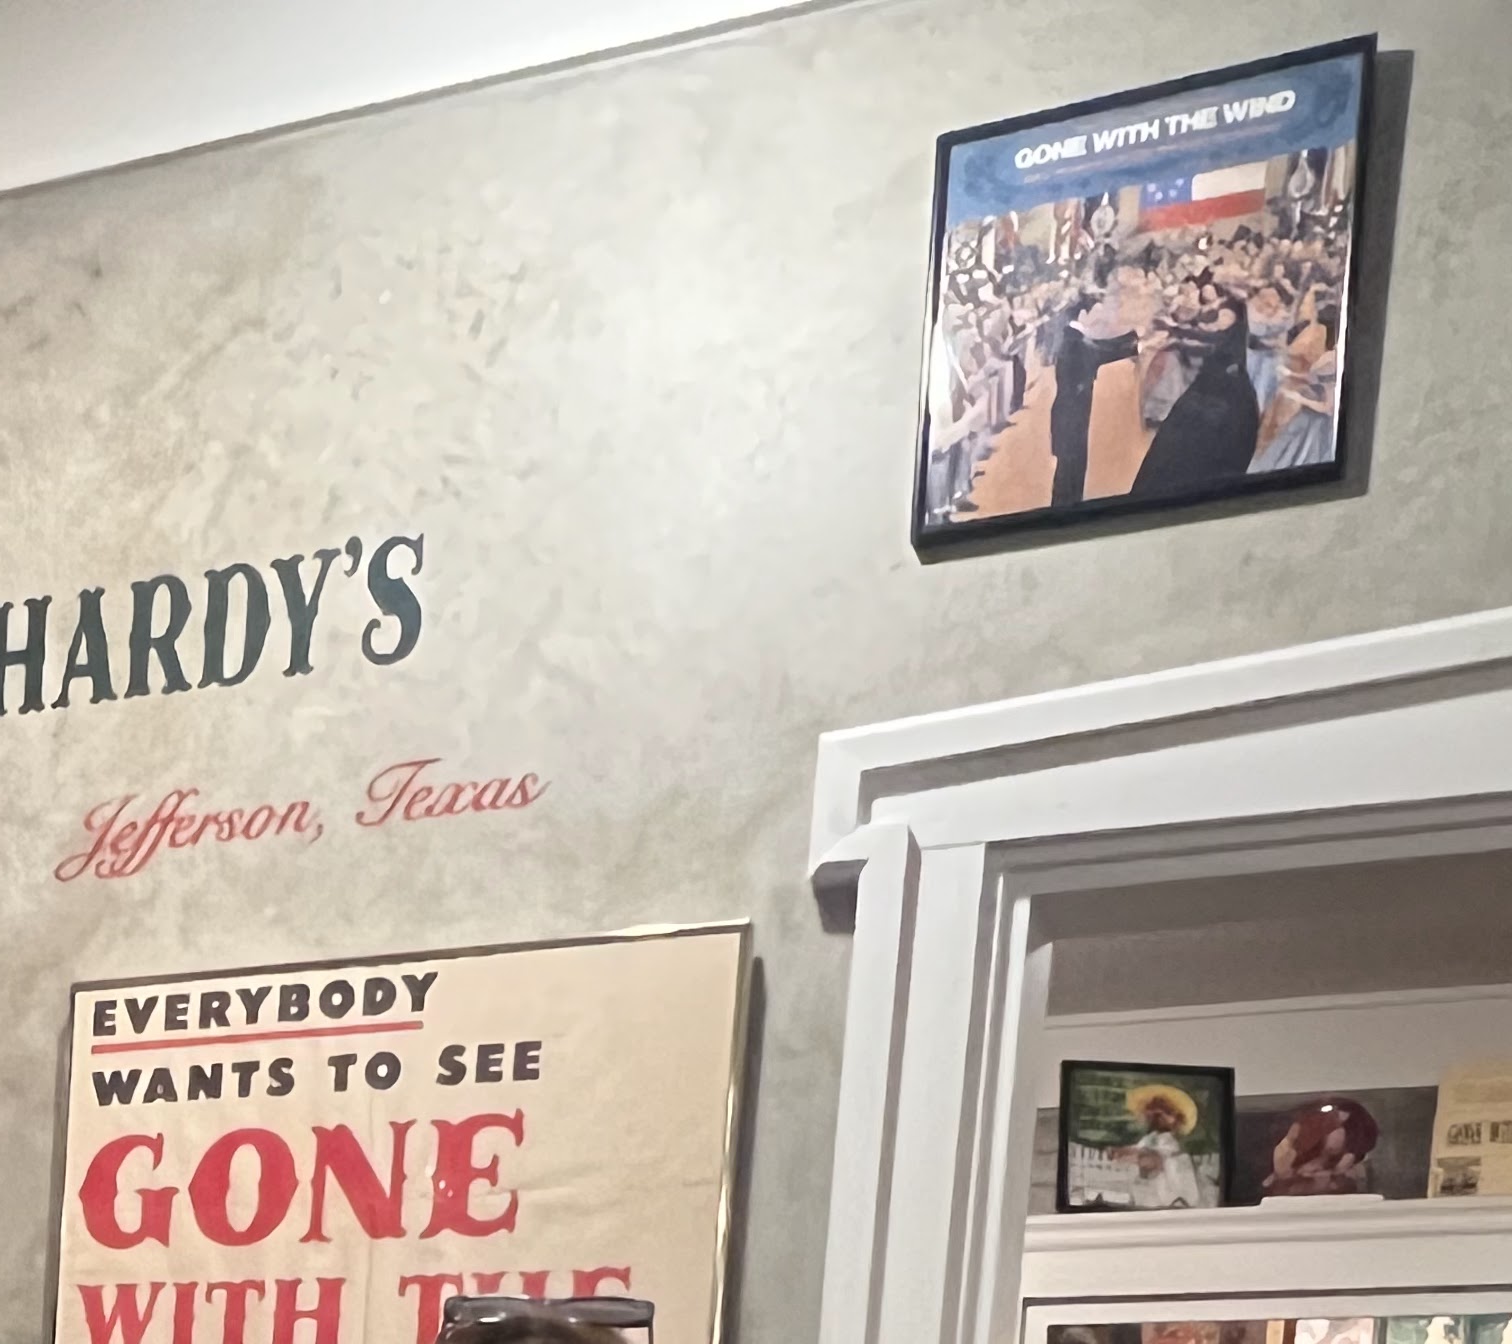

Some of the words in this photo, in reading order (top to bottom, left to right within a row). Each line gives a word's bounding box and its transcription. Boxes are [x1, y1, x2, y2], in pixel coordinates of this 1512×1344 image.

[1014, 135, 1087, 169] GONE
[1092, 118, 1160, 153] WITH
[1164, 105, 1218, 137] THE
[1223, 89, 1297, 124] WIND
[54, 785, 326, 884] Jefferson,
[354, 757, 550, 831] Texas
[92, 971, 439, 1036] EVERYBODY
[91, 1056, 296, 1106] WANTS
[329, 1051, 402, 1092] TO
[437, 1040, 543, 1086] SEE
[78, 1108, 526, 1250] GONE
